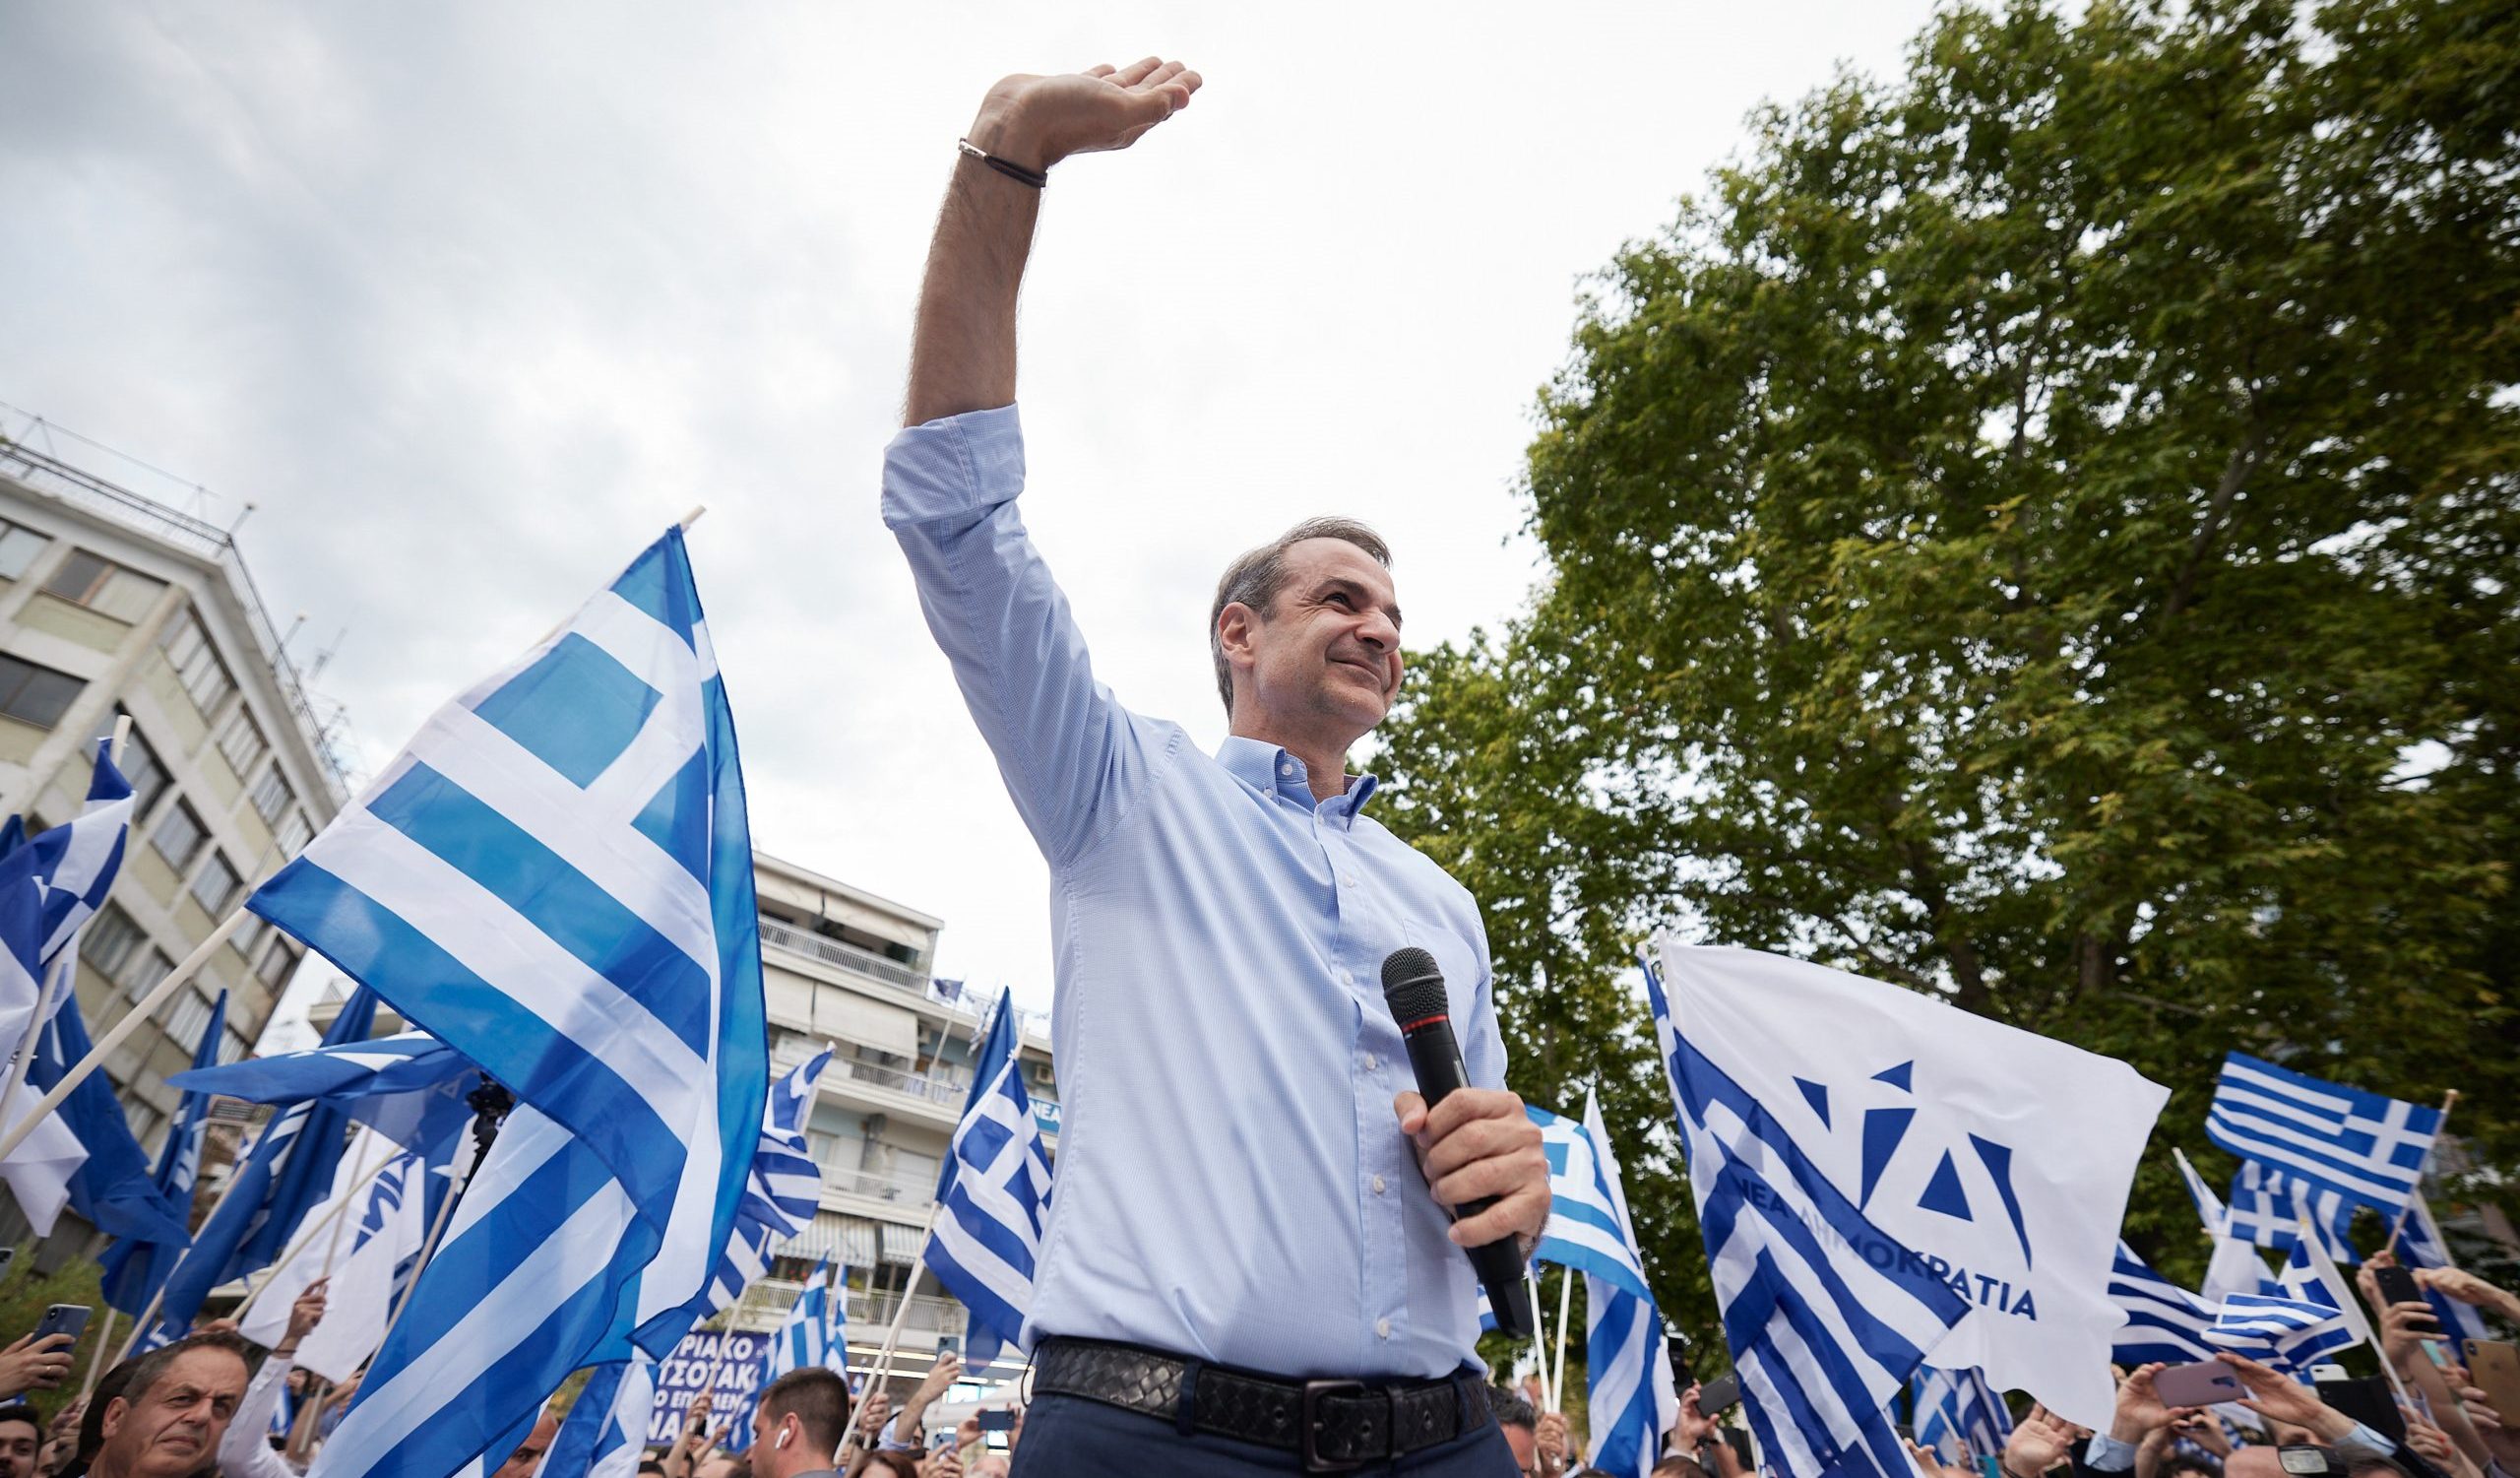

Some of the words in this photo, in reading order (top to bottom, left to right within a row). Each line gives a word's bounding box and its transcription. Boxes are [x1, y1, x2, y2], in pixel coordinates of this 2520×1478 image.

[1738, 1178, 1790, 1219] ΝΕΑ
[1799, 1206, 2037, 1321] ΔΗΜΟΚΡΑΤΙΑ
[678, 1333, 754, 1361] ΡΙΑΚΟ
[658, 1359, 756, 1390] ΤΣΟΤΑΚ
[654, 1389, 668, 1408] Ο
